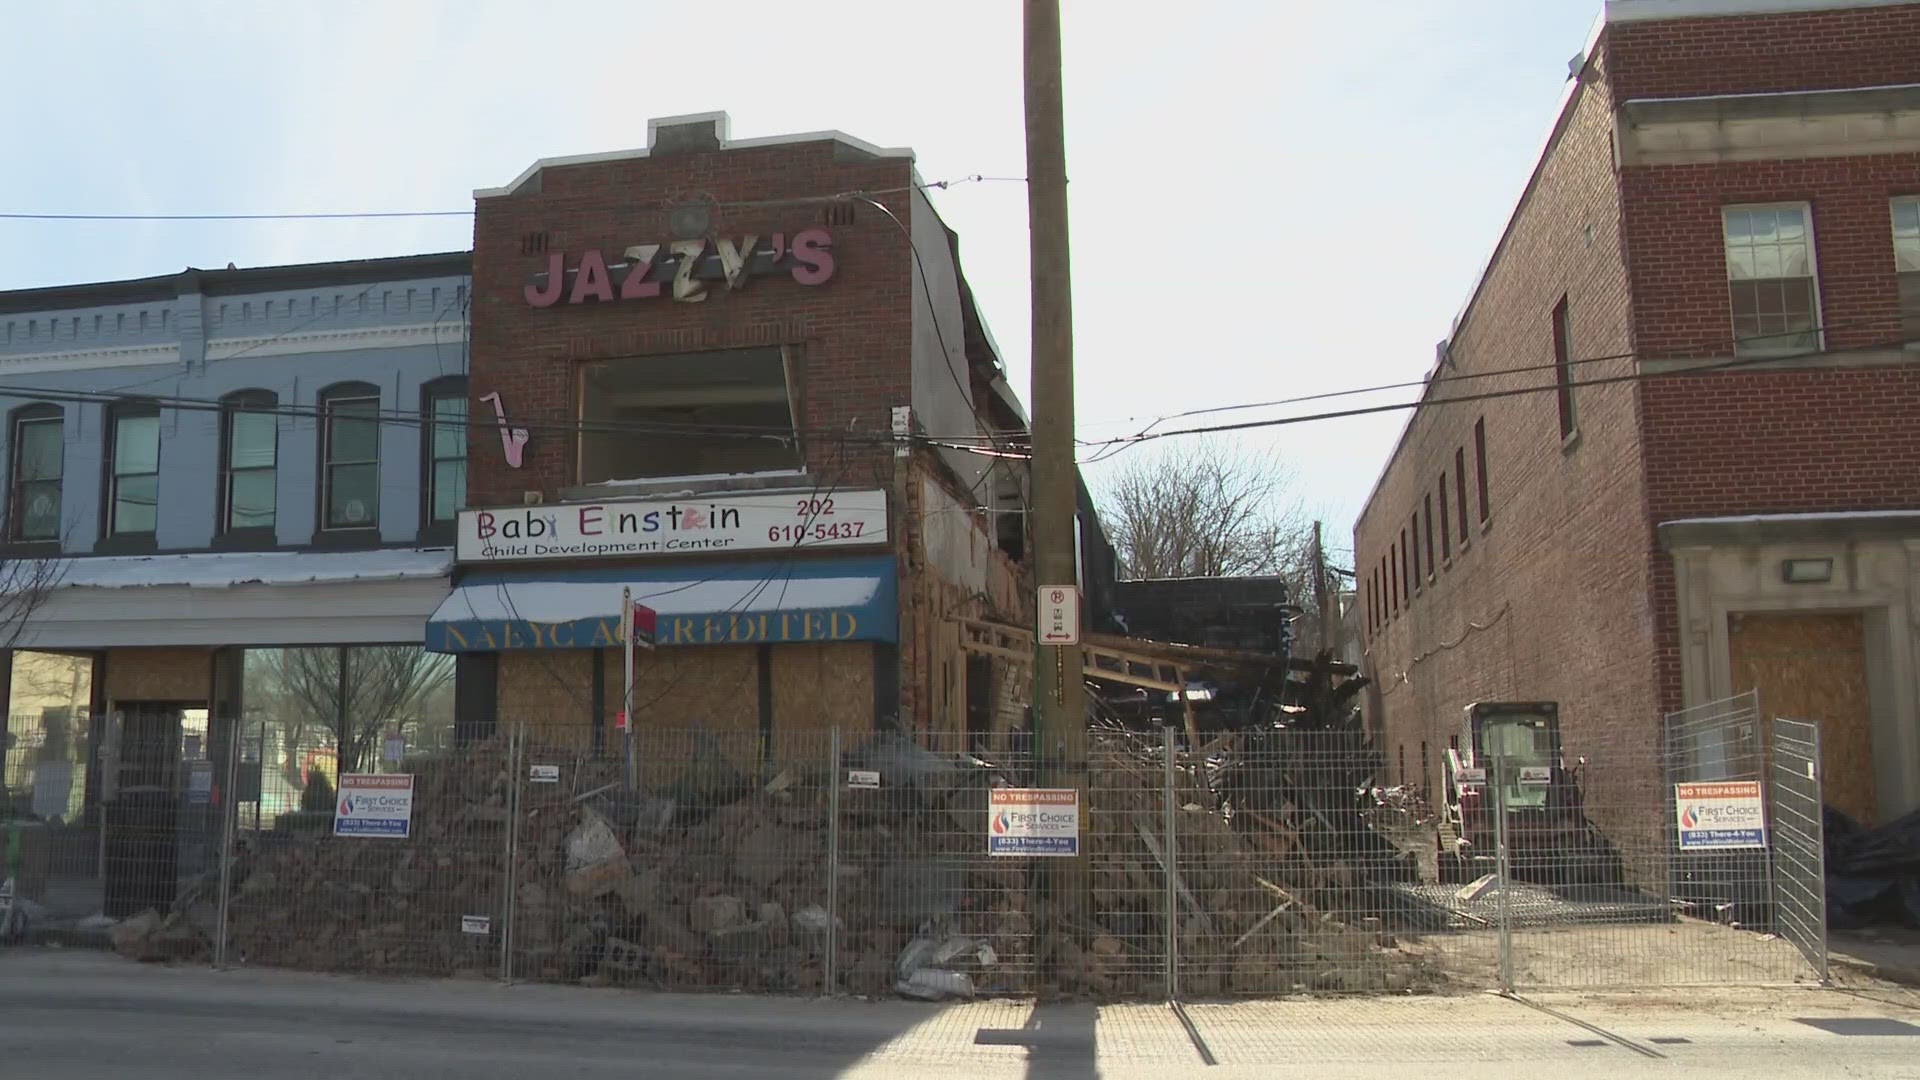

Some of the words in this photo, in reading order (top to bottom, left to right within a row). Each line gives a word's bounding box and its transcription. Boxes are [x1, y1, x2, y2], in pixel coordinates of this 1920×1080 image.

[797, 499, 834, 516] 202
[769, 522, 864, 542] 610-5437
[482, 545, 527, 557] Child
[535, 541, 659, 555] Development
[666, 537, 734, 549] Center
[357, 778, 410, 786] TRESPASSING
[1681, 788, 1694, 796] NO
[1696, 786, 1757, 796] TRESPASSING
[355, 796, 377, 805] FIRST
[380, 796, 408, 806] CHOICE
[993, 793, 1007, 801] NO
[1010, 793, 1074, 801] TRESPASSING
[1698, 806, 1723, 816] FIRST
[1726, 806, 1759, 815] CHOICE
[1011, 812, 1037, 822] FIRST
[1040, 812, 1075, 822] CHOICE
[1026, 822, 1060, 830] SERVICES
